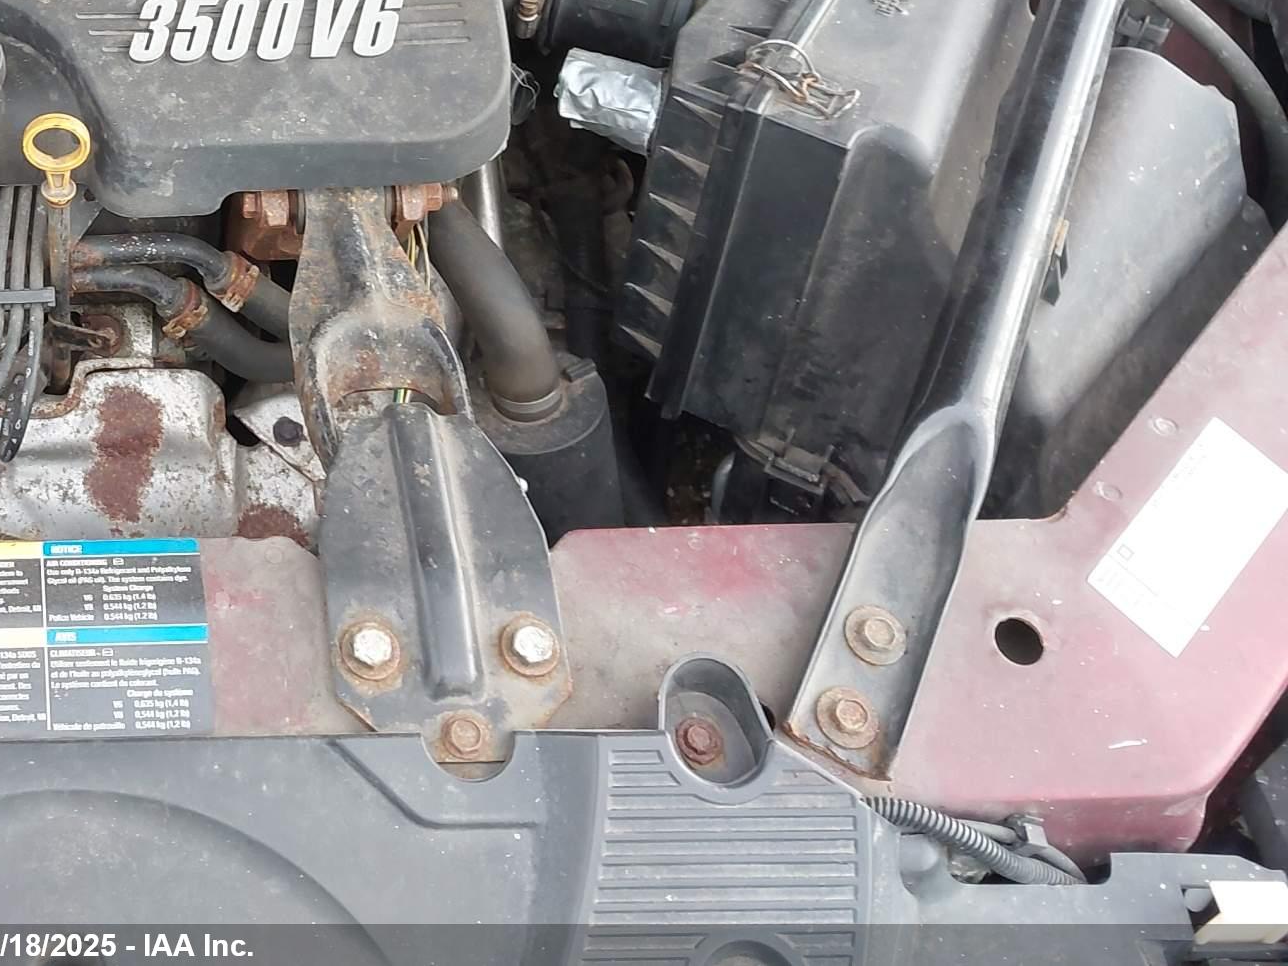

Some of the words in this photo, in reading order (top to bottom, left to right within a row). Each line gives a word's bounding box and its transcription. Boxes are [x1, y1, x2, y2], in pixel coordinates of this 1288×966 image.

[129, 584, 154, 592] Charge
[122, 593, 132, 601] kg
[123, 603, 133, 611] kg
